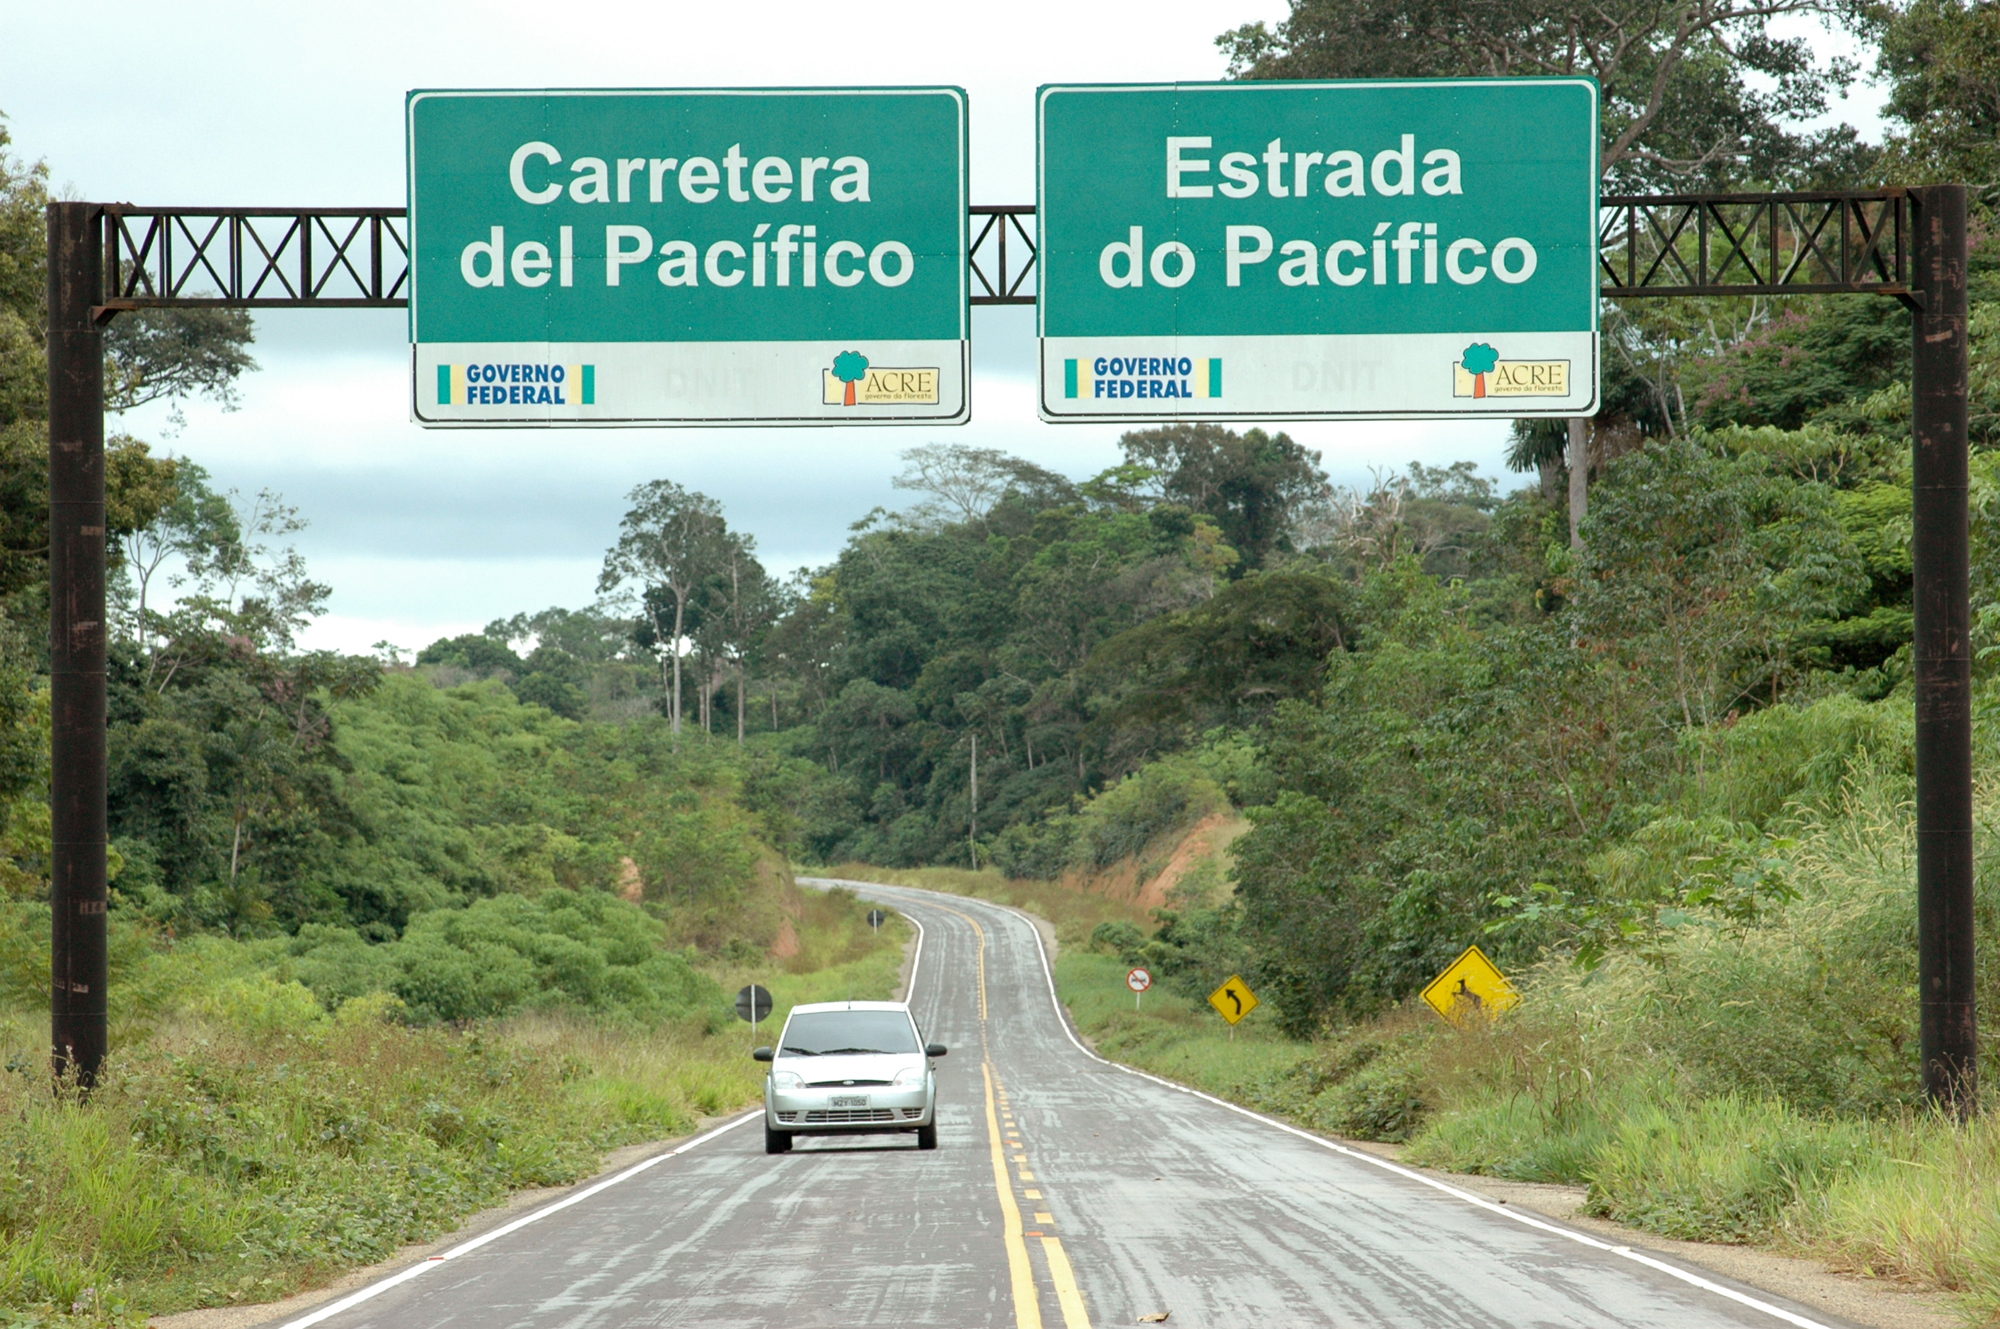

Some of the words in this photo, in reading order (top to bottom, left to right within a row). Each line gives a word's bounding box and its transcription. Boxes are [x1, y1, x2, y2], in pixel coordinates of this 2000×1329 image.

[510, 142, 871, 204] Carretera
[1166, 134, 1463, 198] Estrada
[461, 225, 573, 287] del
[606, 224, 914, 287] Pacífico
[1100, 226, 1195, 288] do
[1226, 222, 1538, 287] Pacífico
[467, 364, 565, 383] GOVERNO
[1094, 357, 1192, 376] GOVERNO
[1292, 361, 1382, 391] DNIT
[1496, 365, 1562, 385] ACRE
[866, 372, 931, 392] ACRE
[1095, 380, 1192, 398] FEDERAL
[467, 386, 565, 404] FEDERAL
